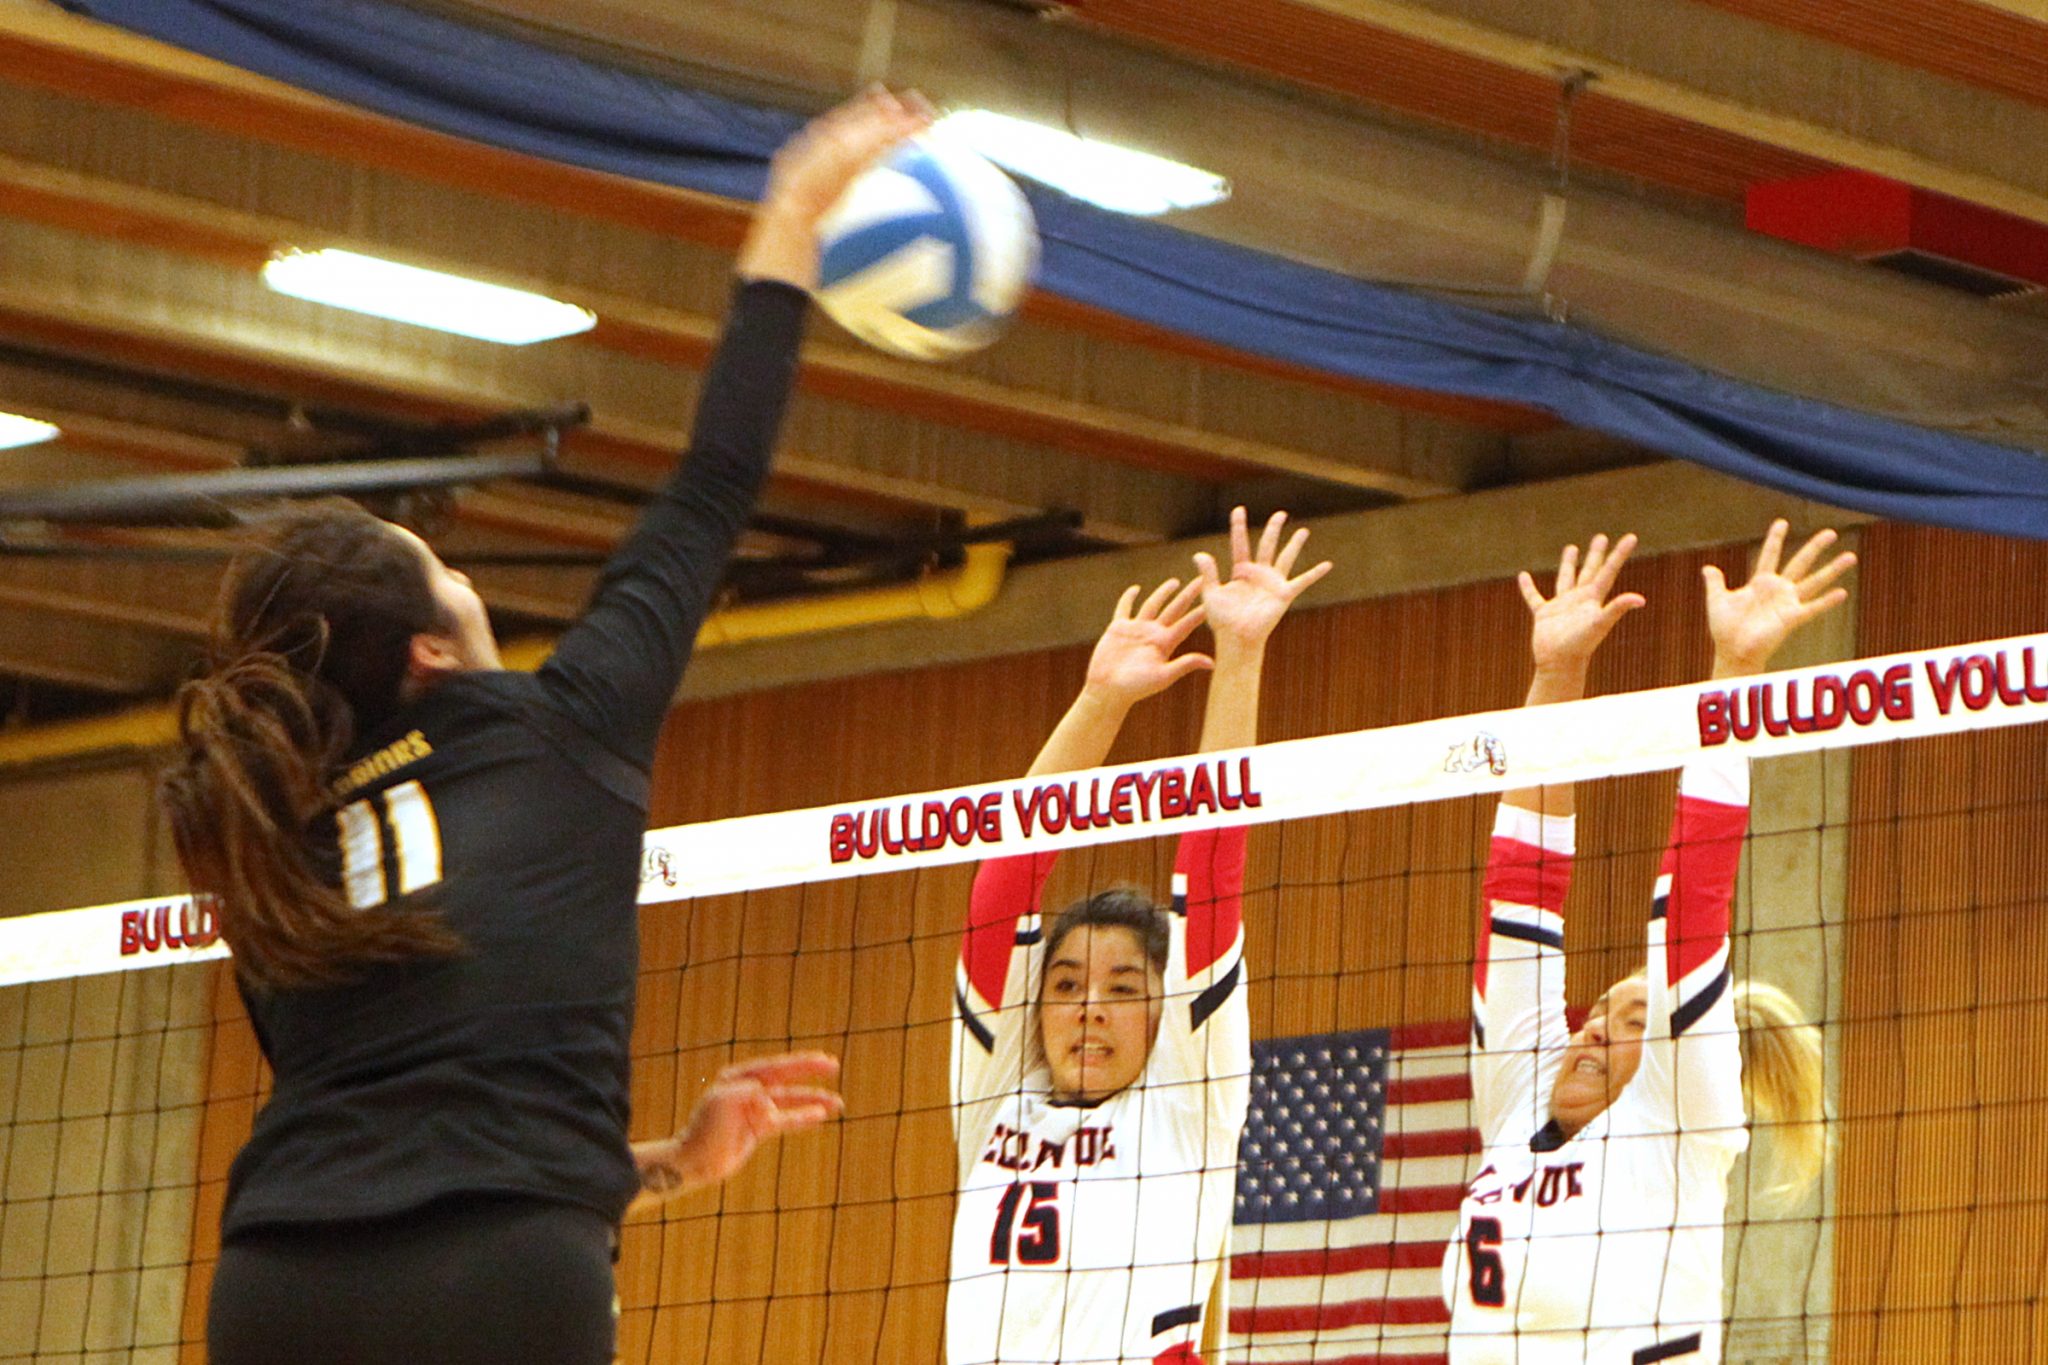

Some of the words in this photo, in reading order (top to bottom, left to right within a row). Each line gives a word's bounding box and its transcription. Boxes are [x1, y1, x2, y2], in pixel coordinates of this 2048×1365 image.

[1697, 662, 1914, 747] BULLDOG
[336, 779, 444, 910] 11
[829, 791, 1003, 864] BULLDOG
[1012, 756, 1262, 838] VOLLEYBALL
[990, 1181, 1060, 1265] 15
[1466, 1215, 1505, 1308] 6
